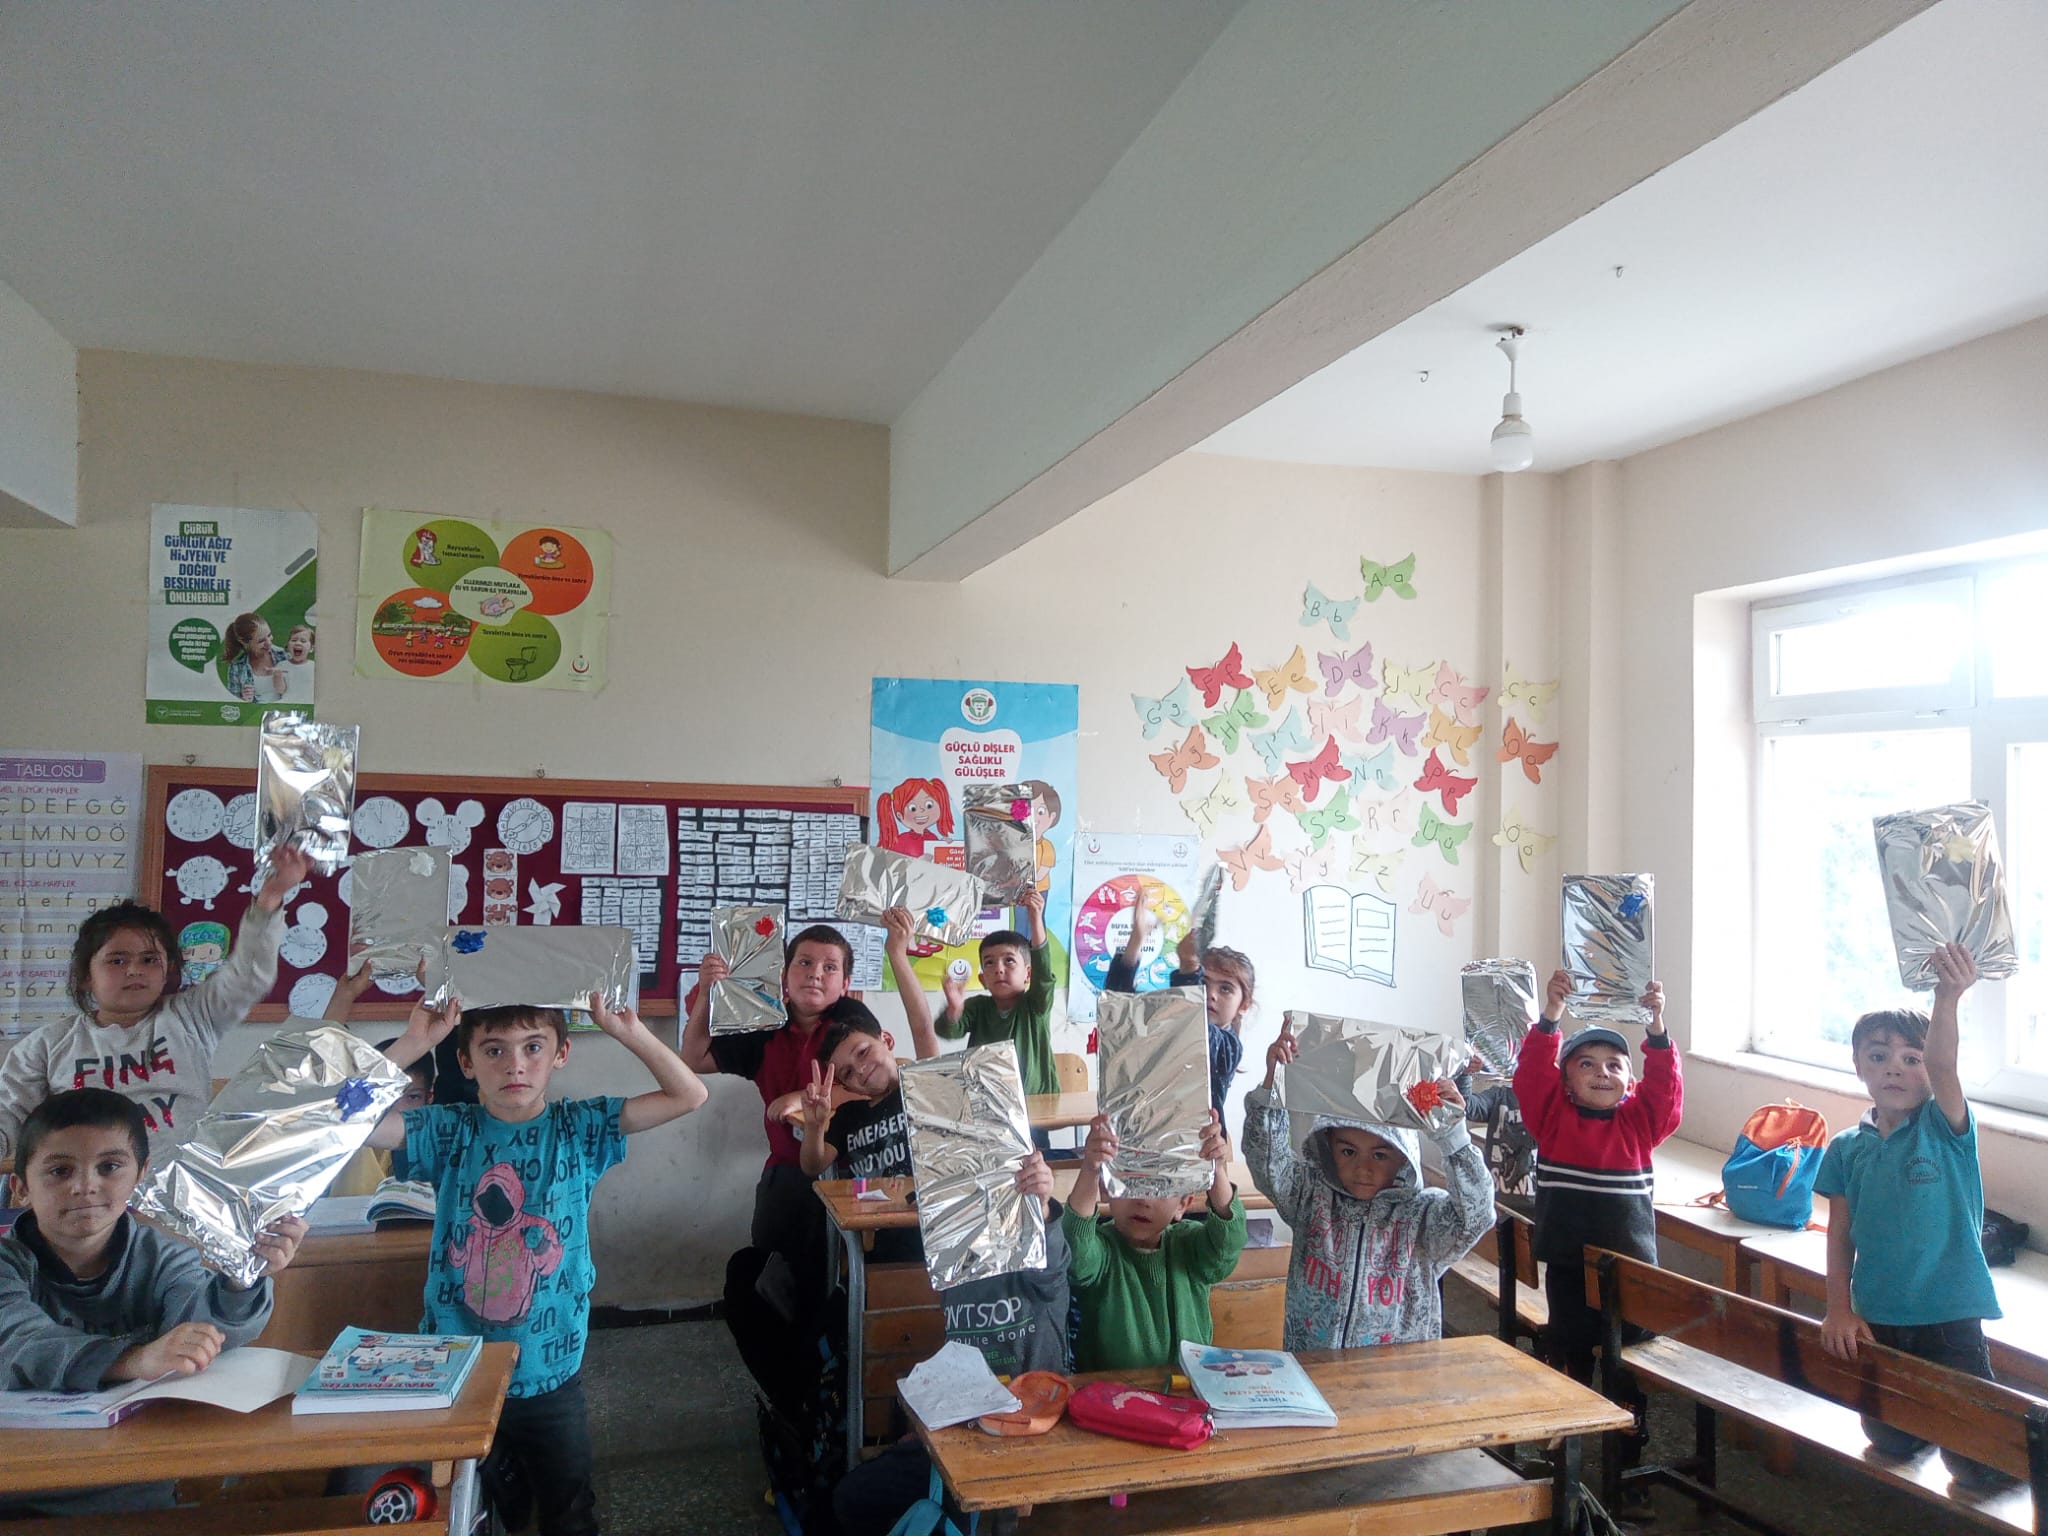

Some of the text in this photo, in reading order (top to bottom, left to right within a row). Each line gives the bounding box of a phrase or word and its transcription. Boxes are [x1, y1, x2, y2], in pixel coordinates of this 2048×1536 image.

[164, 534, 232, 550] GÜNLÜK AĞIZ
[214, 550, 227, 563] VE
[179, 563, 217, 577] DOĞRU
[164, 576, 216, 592] BESLENME
[1371, 573, 1403, 588] A a
[1311, 601, 1342, 622] B b
[1332, 662, 1361, 683] D d
[1202, 674, 1213, 694] F
[1267, 673, 1303, 695] E e
[1390, 675, 1399, 693] J
[1147, 707, 1161, 724] G
[1220, 709, 1253, 740] H h
[1433, 721, 1442, 742] L
[945, 740, 1015, 755] GÜÇLÜ DİŞLER
[1507, 739, 1519, 755] O
[958, 754, 1002, 765] SAĞLIKLI
[14, 763, 83, 778] TABLOSU
[954, 766, 1006, 779] GÜLÜŞLER
[1303, 769, 1316, 788] M
[1354, 764, 1383, 784] N n
[45, 784, 80, 795] HARFLER
[1427, 767, 1455, 797] P p
[21, 797, 36, 814] D
[46, 798, 57, 814] E
[66, 798, 77, 814] F
[86, 799, 101, 814] G
[110, 795, 126, 815] Ğ
[1194, 795, 1237, 824] T t
[1310, 816, 1325, 839] S
[1368, 807, 1379, 831] R
[12, 823, 125, 842] L M N O Ö
[0, 849, 126, 869] T U Ü V Y Z
[1229, 851, 1247, 871] V
[1355, 852, 1389, 876] Z z
[1292, 859, 1328, 881] Y y
[17, 890, 26, 907] d
[41, 897, 51, 907] e
[65, 891, 74, 907] f
[87, 897, 97, 914] g
[1421, 889, 1434, 909] U
[37, 922, 53, 933] m
[67, 922, 77, 933] n
[22, 947, 32, 960] u
[45, 946, 55, 960] ü
[5, 981, 57, 998] 5 6 7
[507, 1126, 540, 1147] BY
[481, 1143, 498, 1167] X
[530, 1307, 556, 1335] UP
[944, 1296, 1021, 1330] N'T STOP
[997, 1323, 1036, 1342] done
[541, 1330, 580, 1364] THE
